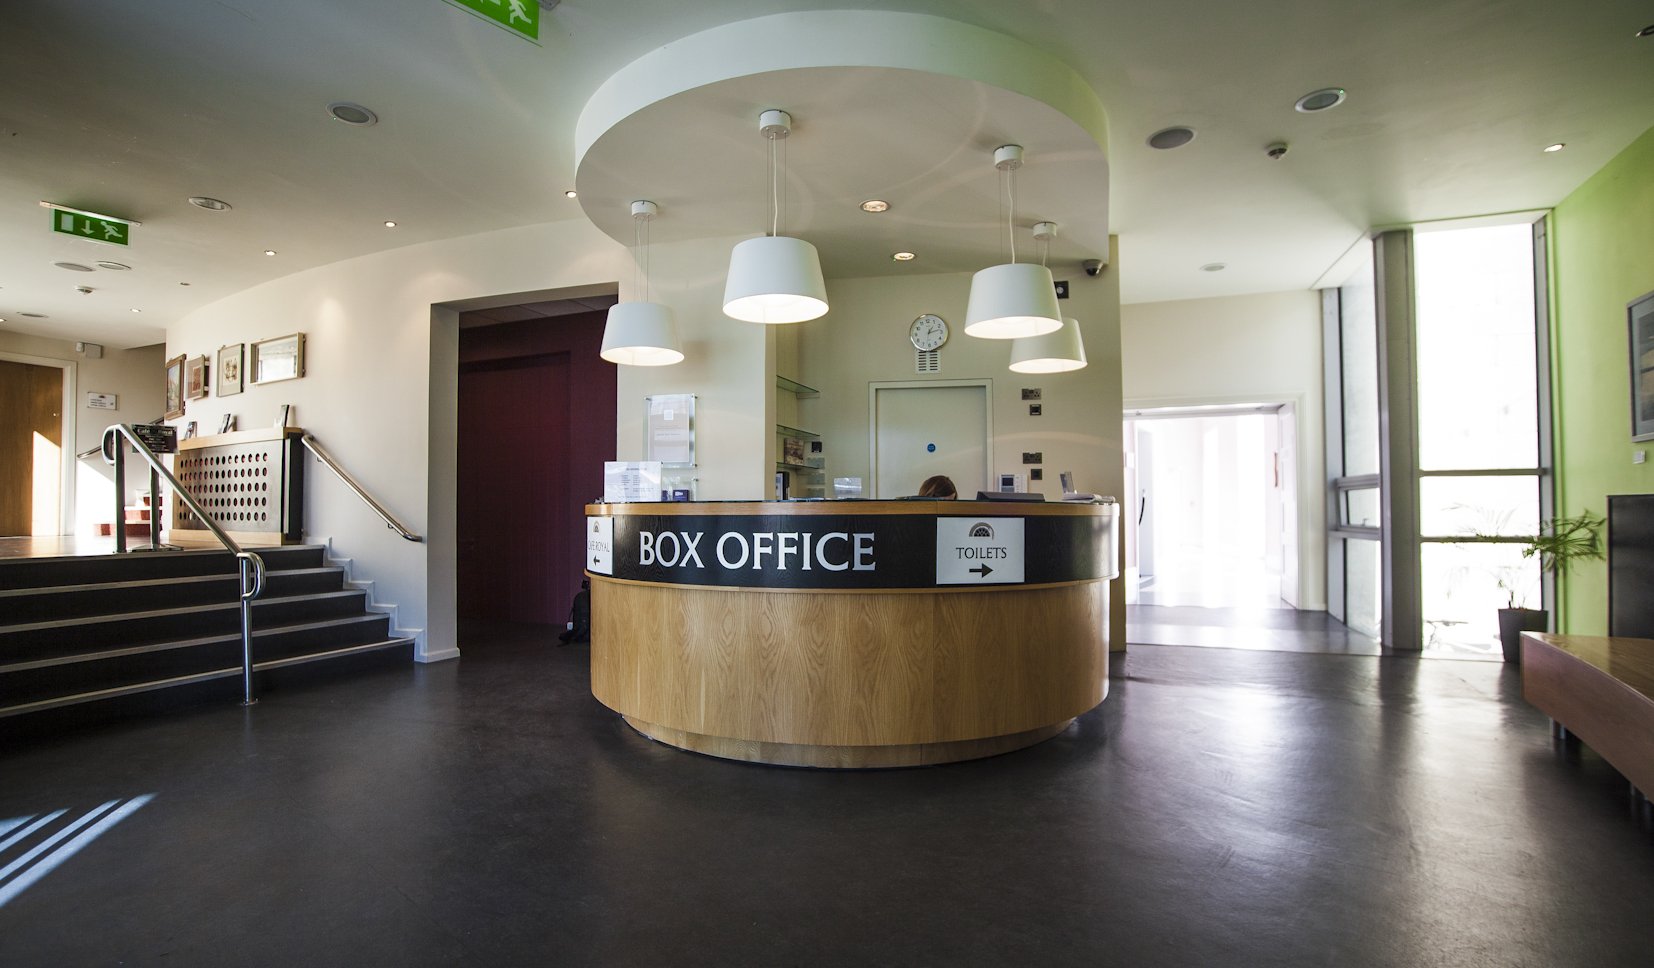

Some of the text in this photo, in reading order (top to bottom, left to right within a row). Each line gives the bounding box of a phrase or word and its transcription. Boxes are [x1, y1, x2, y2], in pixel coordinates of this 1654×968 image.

[639, 531, 876, 571] BOX OFFICE
[955, 547, 1007, 559] TOILETS
